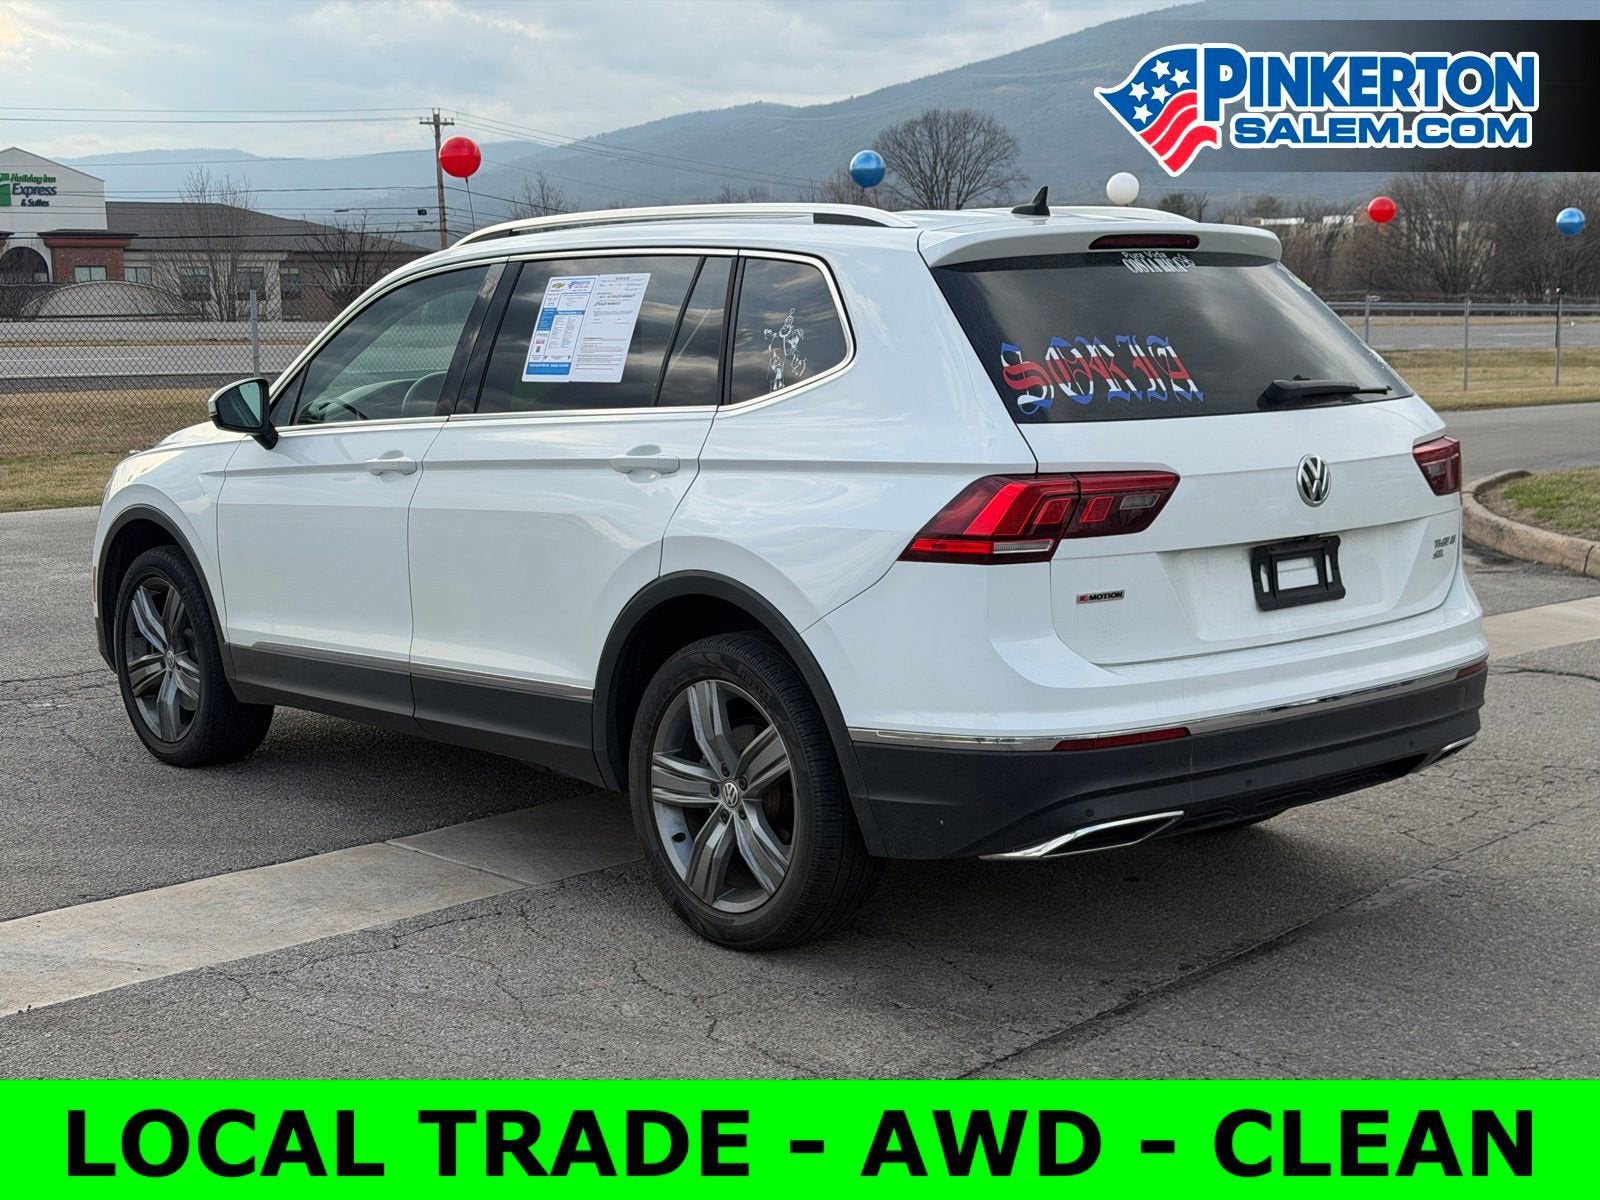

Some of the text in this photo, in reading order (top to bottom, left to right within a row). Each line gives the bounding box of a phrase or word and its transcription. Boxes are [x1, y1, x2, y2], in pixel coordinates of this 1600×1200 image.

[11, 173, 42, 184] Holiday
[12, 183, 57, 198] Express
[21, 198, 49, 207] & Suites
